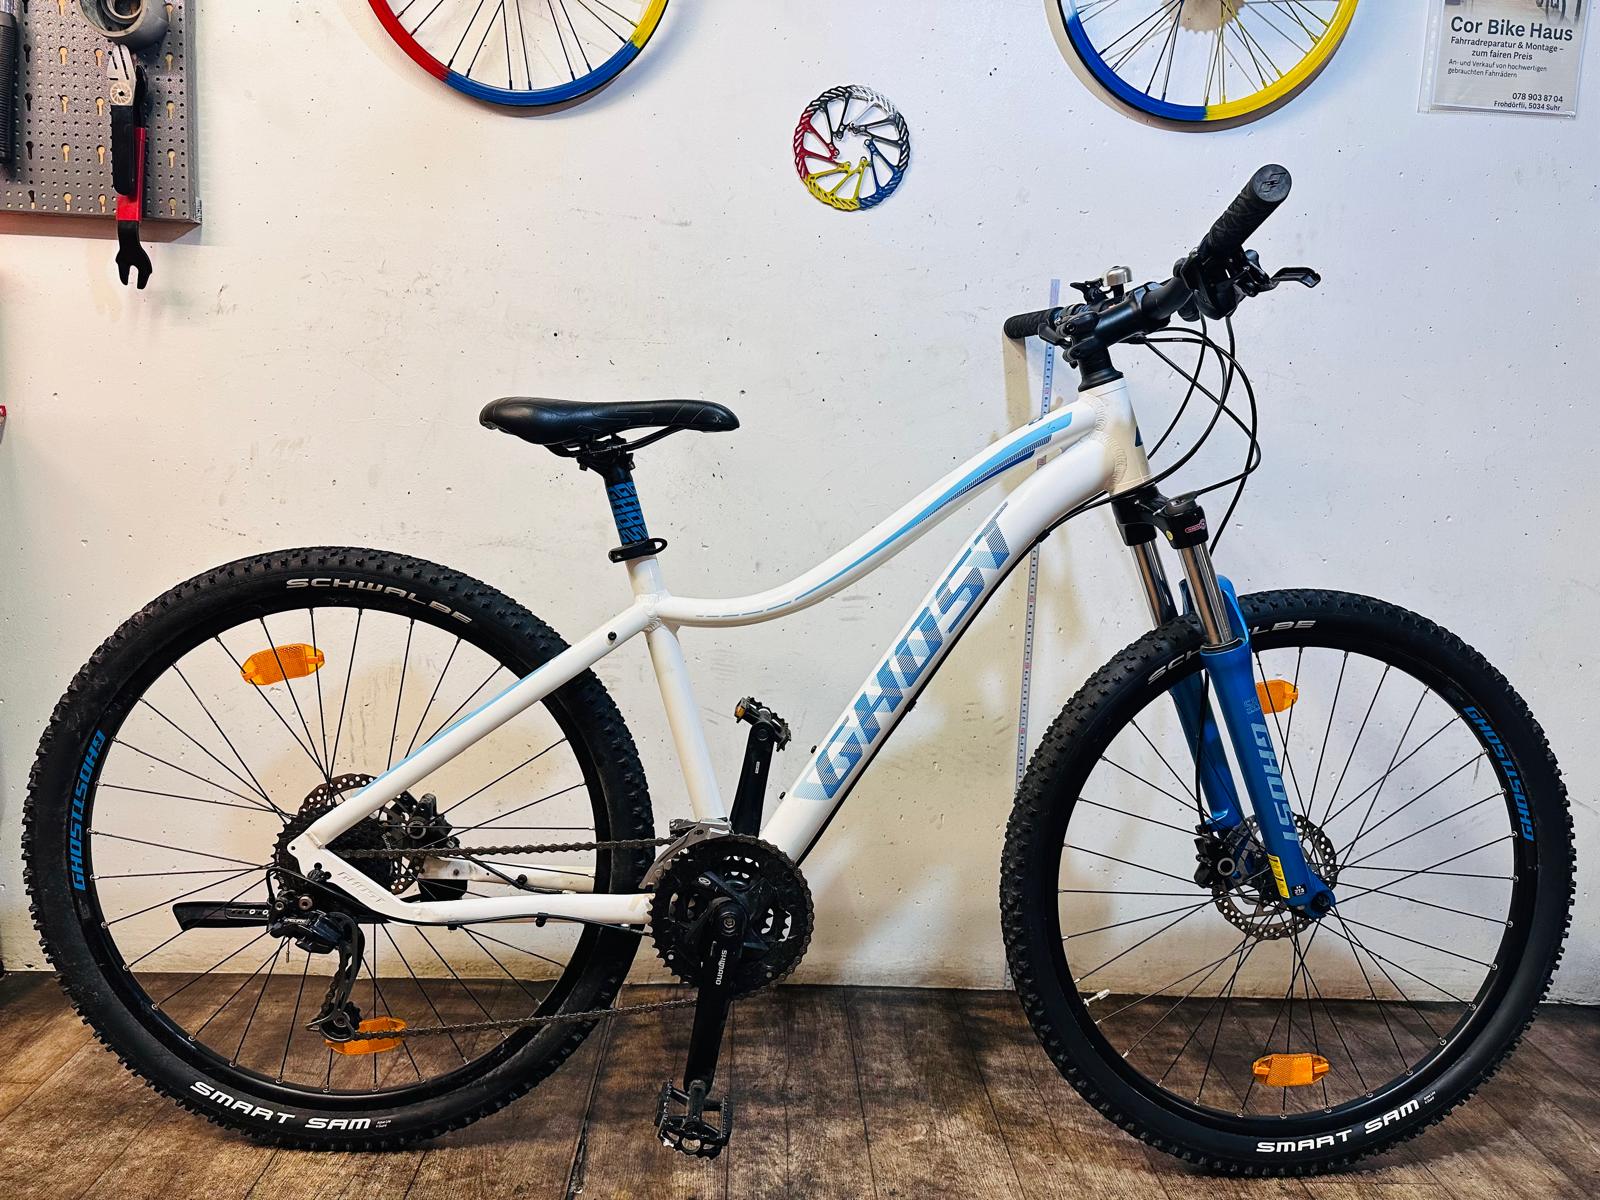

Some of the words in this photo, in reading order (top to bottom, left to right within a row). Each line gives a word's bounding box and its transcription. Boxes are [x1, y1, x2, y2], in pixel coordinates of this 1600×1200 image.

[1451, 16, 1483, 34] Cor
[1487, 19, 1525, 37] Bike
[1530, 22, 1573, 41] Haus
[1450, 36, 1516, 49] Fahrradreparatur
[1526, 42, 1558, 53] Montage
[1489, 50, 1512, 58] fairen
[1513, 52, 1533, 60] Preis
[1472, 61, 1495, 69] Verkauf
[1507, 63, 1548, 72] hochwertigen
[1512, 92, 1526, 100] 078
[1528, 93, 1542, 101] 903
[1543, 94, 1553, 102] 87
[1528, 102, 1545, 110] 5034
[286, 578, 473, 624] SCHWALBE
[814, 502, 1010, 799] GHOST
[1251, 722, 1300, 842] GHOST
[715, 949, 728, 986] SHIMANO
[189, 1081, 296, 1124] SMART
[304, 1117, 372, 1130] SAM
[1256, 1129, 1353, 1153] SMART
[1364, 1099, 1420, 1134] SAM
